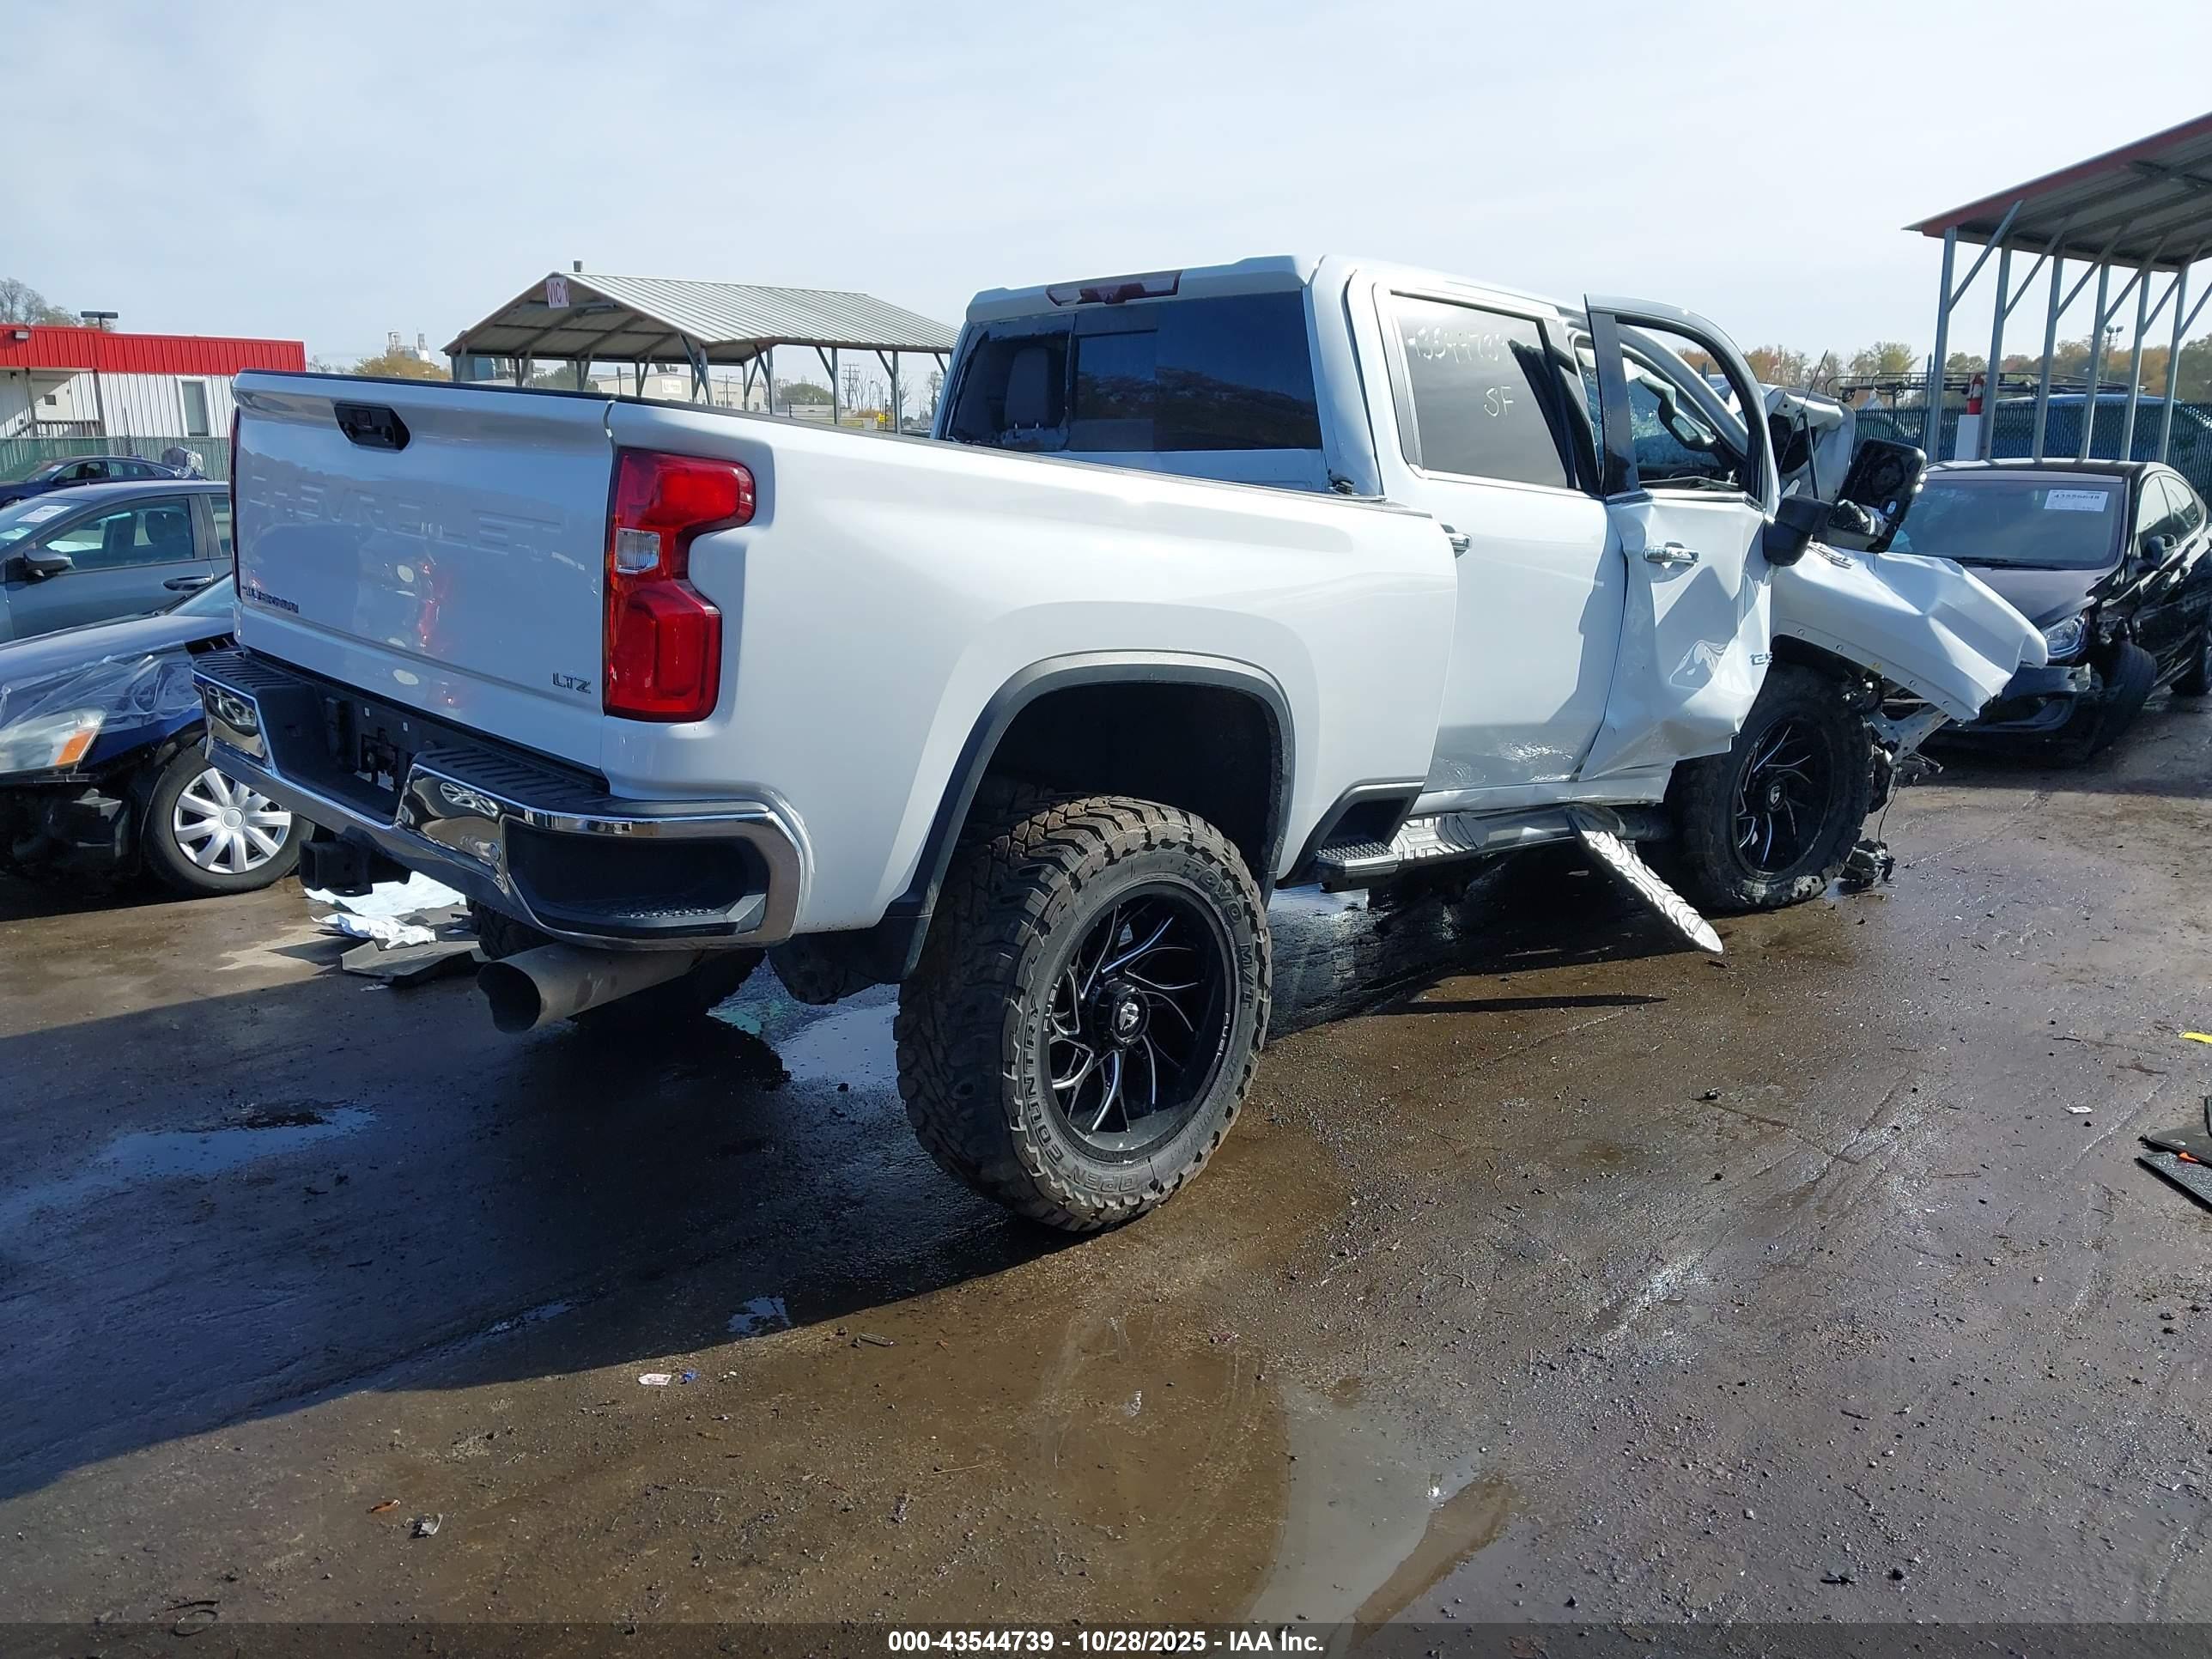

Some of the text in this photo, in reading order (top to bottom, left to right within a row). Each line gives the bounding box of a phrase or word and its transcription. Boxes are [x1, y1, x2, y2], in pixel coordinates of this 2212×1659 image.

[546, 282, 562, 303] VIC
[1484, 386, 1514, 417] SF
[552, 672, 592, 694] LTZ
[1181, 859, 1243, 927] TOYO
[1240, 943, 1255, 1010] M/T
[1043, 975, 1062, 1031] FUEL
[1214, 1012, 1231, 1063] FUEL
[1023, 994, 1064, 1166] COUNTRY
[1067, 1165, 1139, 1193] OPEN
